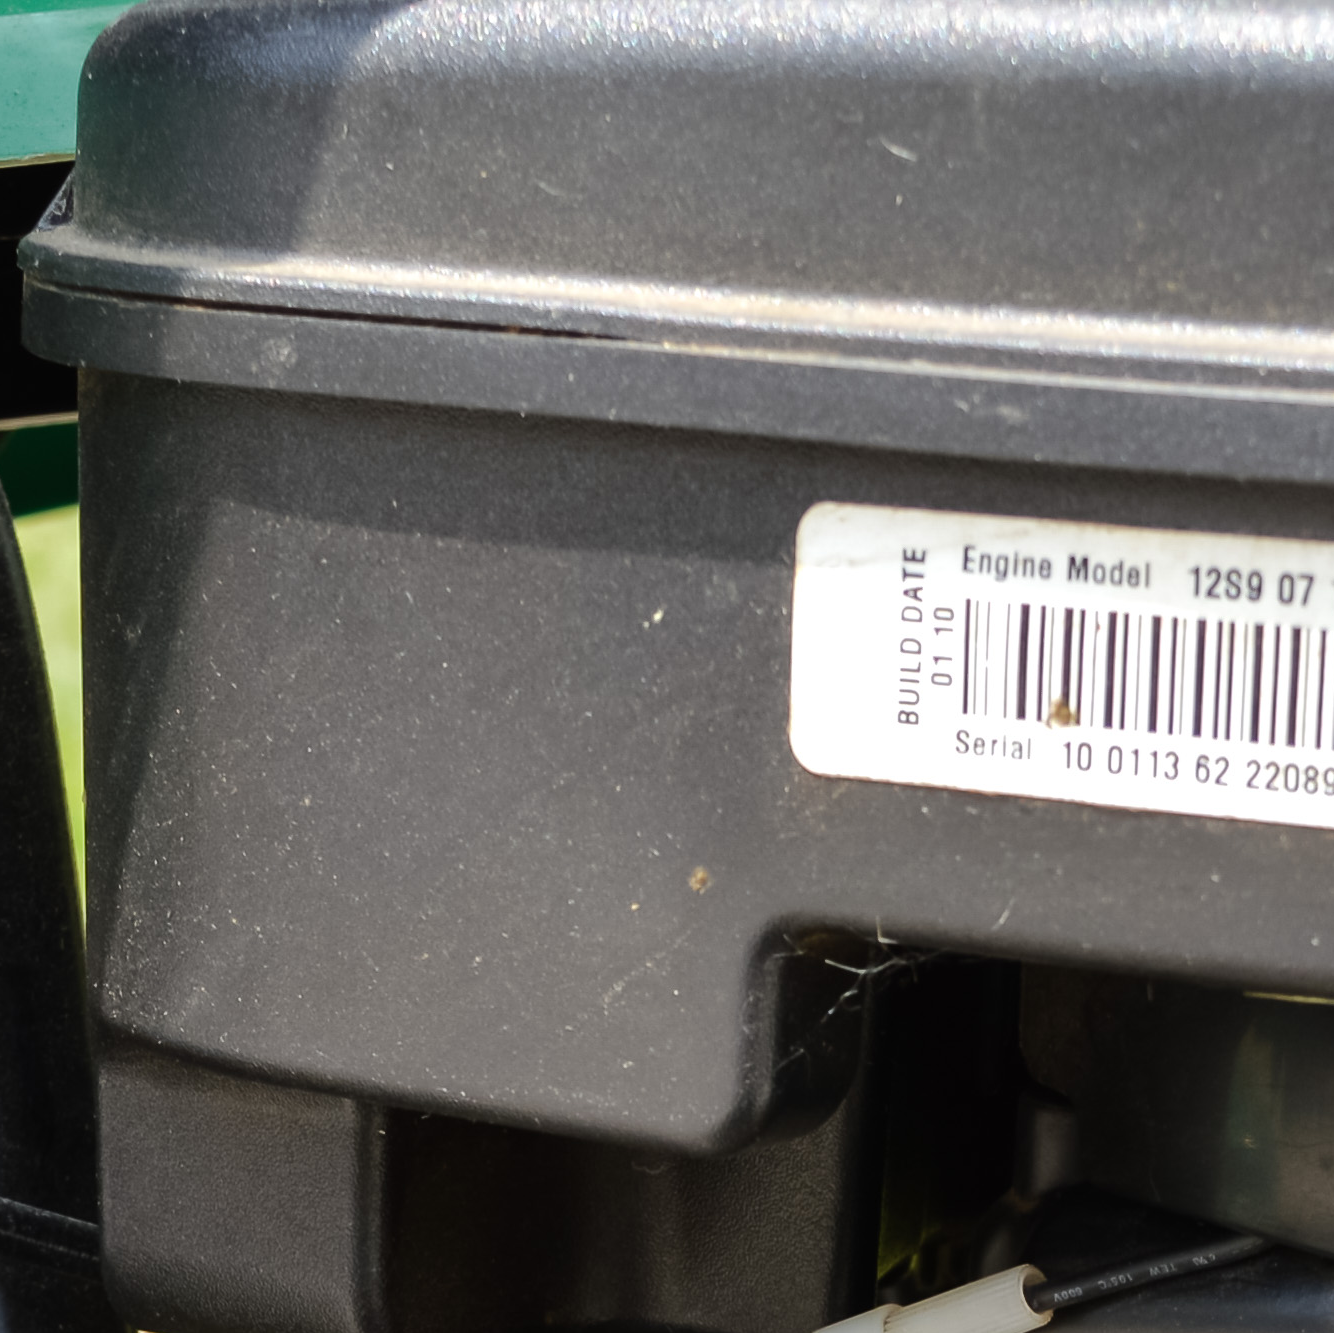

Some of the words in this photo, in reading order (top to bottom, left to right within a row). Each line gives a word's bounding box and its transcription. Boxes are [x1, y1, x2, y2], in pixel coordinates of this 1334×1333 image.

[901, 547, 927, 623] DATE
[961, 544, 1053, 583] Engine
[1068, 555, 1151, 589] Model
[1189, 566, 1264, 601] 12S9
[1278, 575, 1315, 607] 07
[933, 606, 955, 636] 10
[897, 637, 922, 726] BUILD
[930, 655, 953, 687] 01
[955, 729, 1032, 760] Serial
[1063, 741, 1093, 771] 10
[1107, 745, 1180, 781] 0113
[1195, 754, 1230, 787] 62
